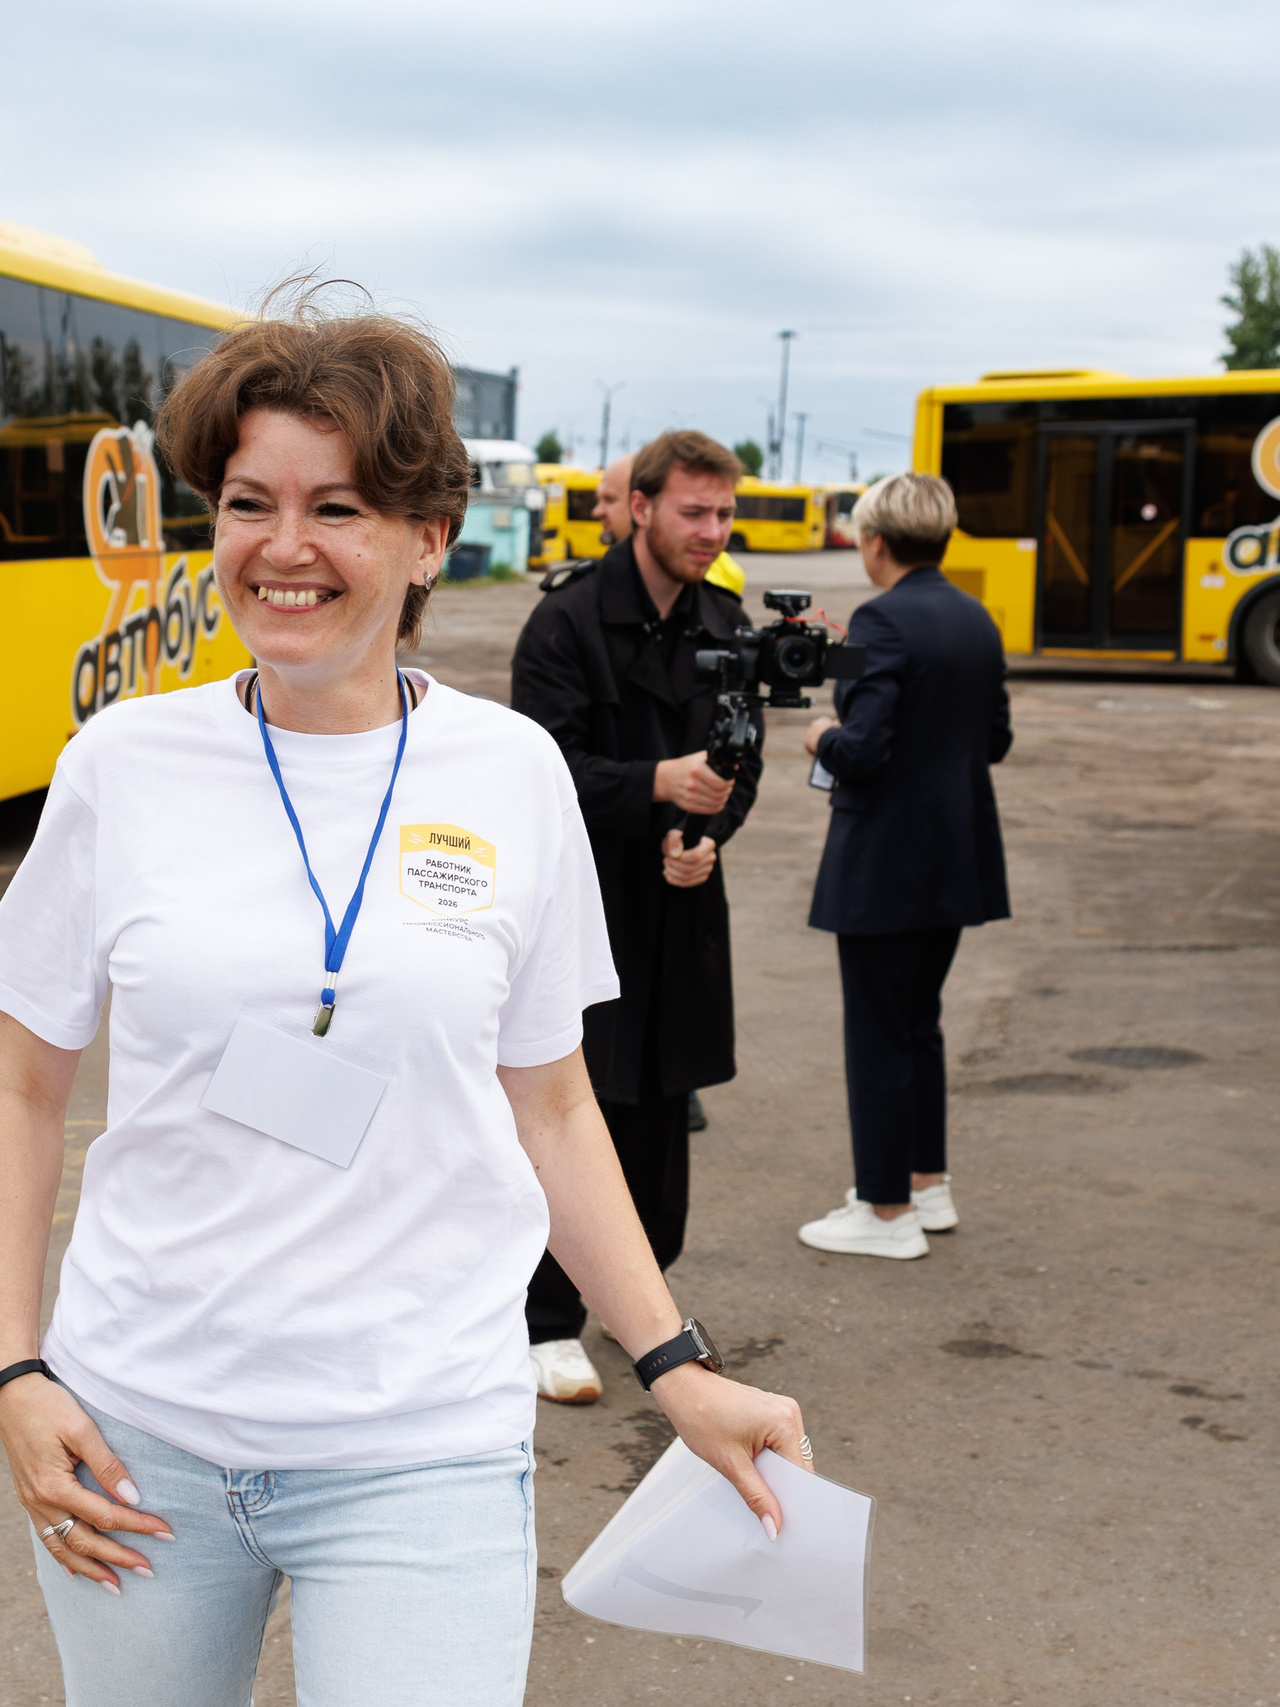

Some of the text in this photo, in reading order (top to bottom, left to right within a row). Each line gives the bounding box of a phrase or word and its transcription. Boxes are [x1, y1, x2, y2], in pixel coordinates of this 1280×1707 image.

[73, 558, 220, 722] автобус
[429, 832, 471, 850] ЛУЧШИЙ
[425, 858, 472, 875] РАБОТНИК
[407, 867, 488, 888] ПАССАЖИРСКОГО
[418, 880, 477, 897] ТРАНСПОРТА
[438, 898, 458, 908] 2026
[425, 926, 474, 943] МАСТЕРСТВА
